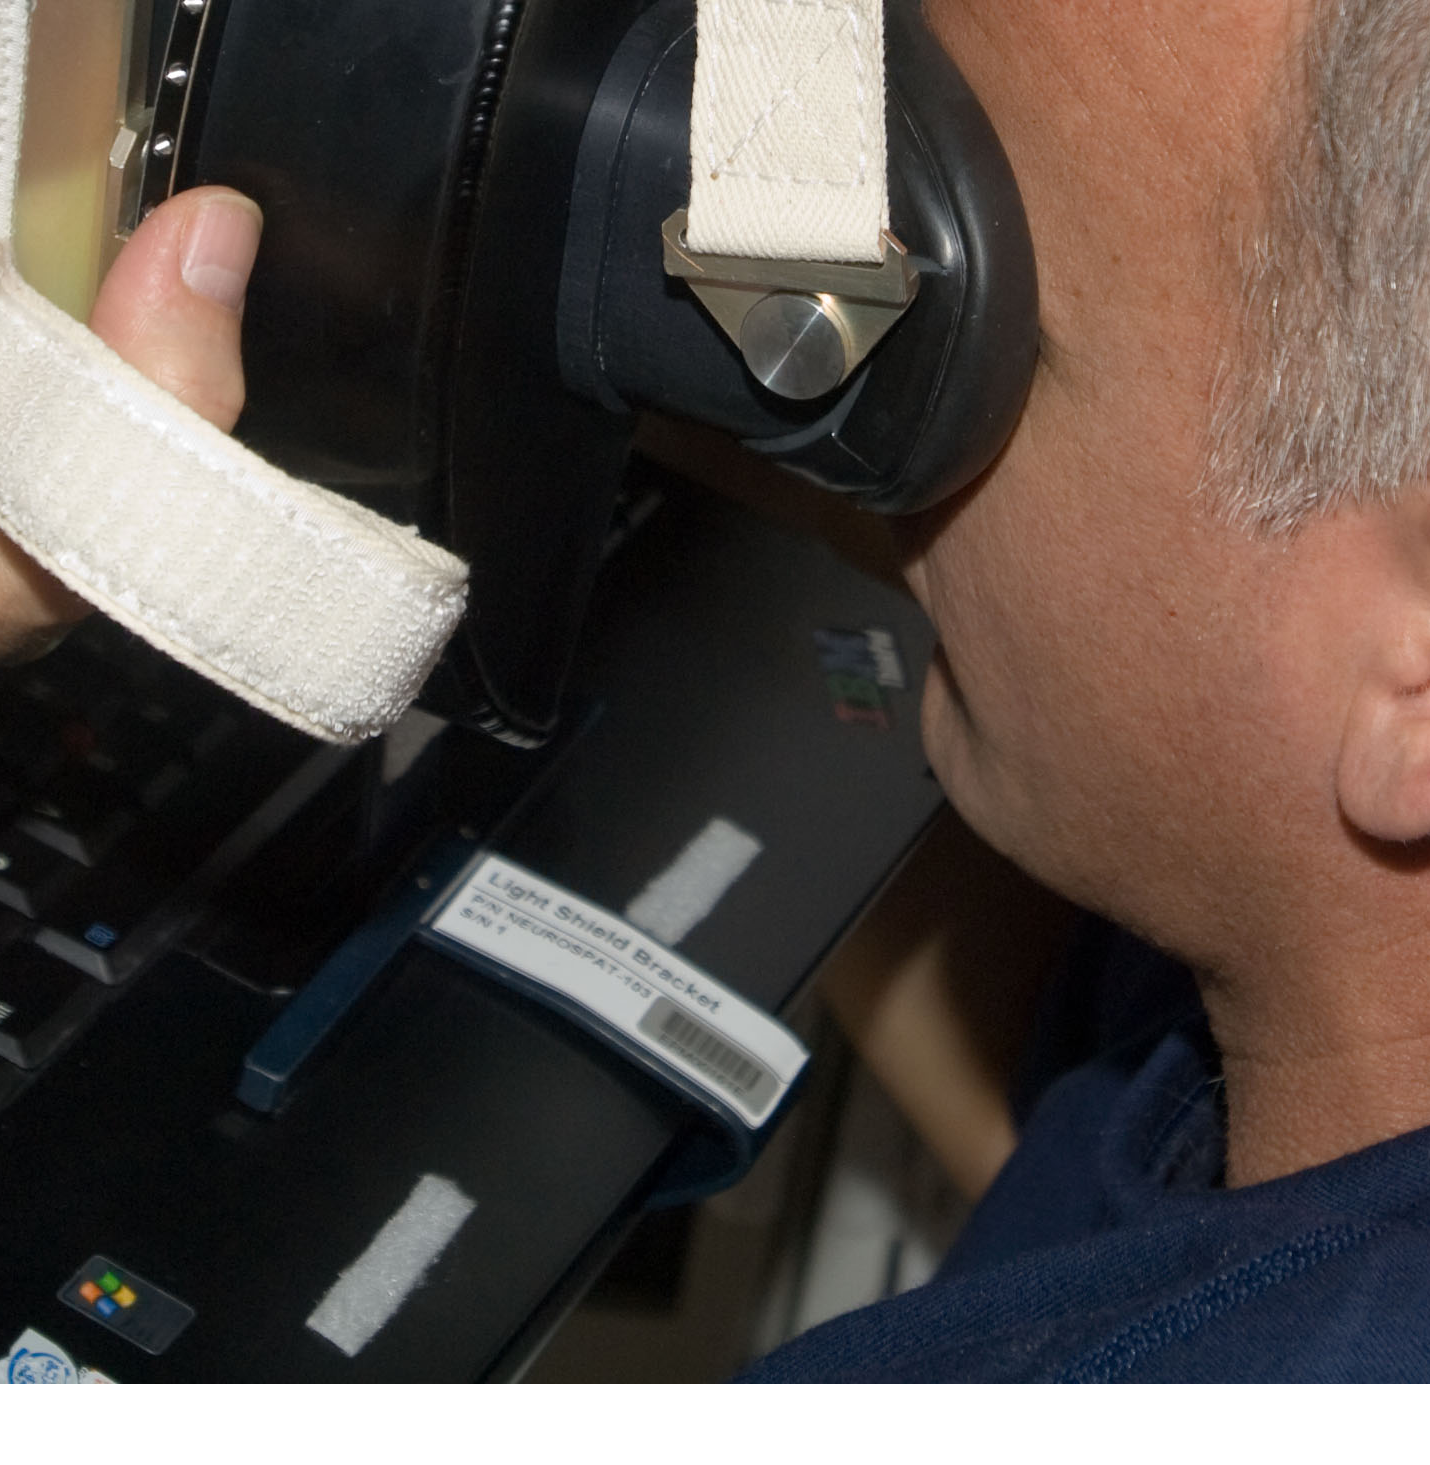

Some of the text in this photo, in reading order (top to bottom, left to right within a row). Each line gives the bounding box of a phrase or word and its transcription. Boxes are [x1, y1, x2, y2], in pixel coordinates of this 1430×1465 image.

[471, 892, 503, 916] P/N
[459, 906, 492, 929] S/N
[488, 872, 723, 1016] Light Shield Bracket
